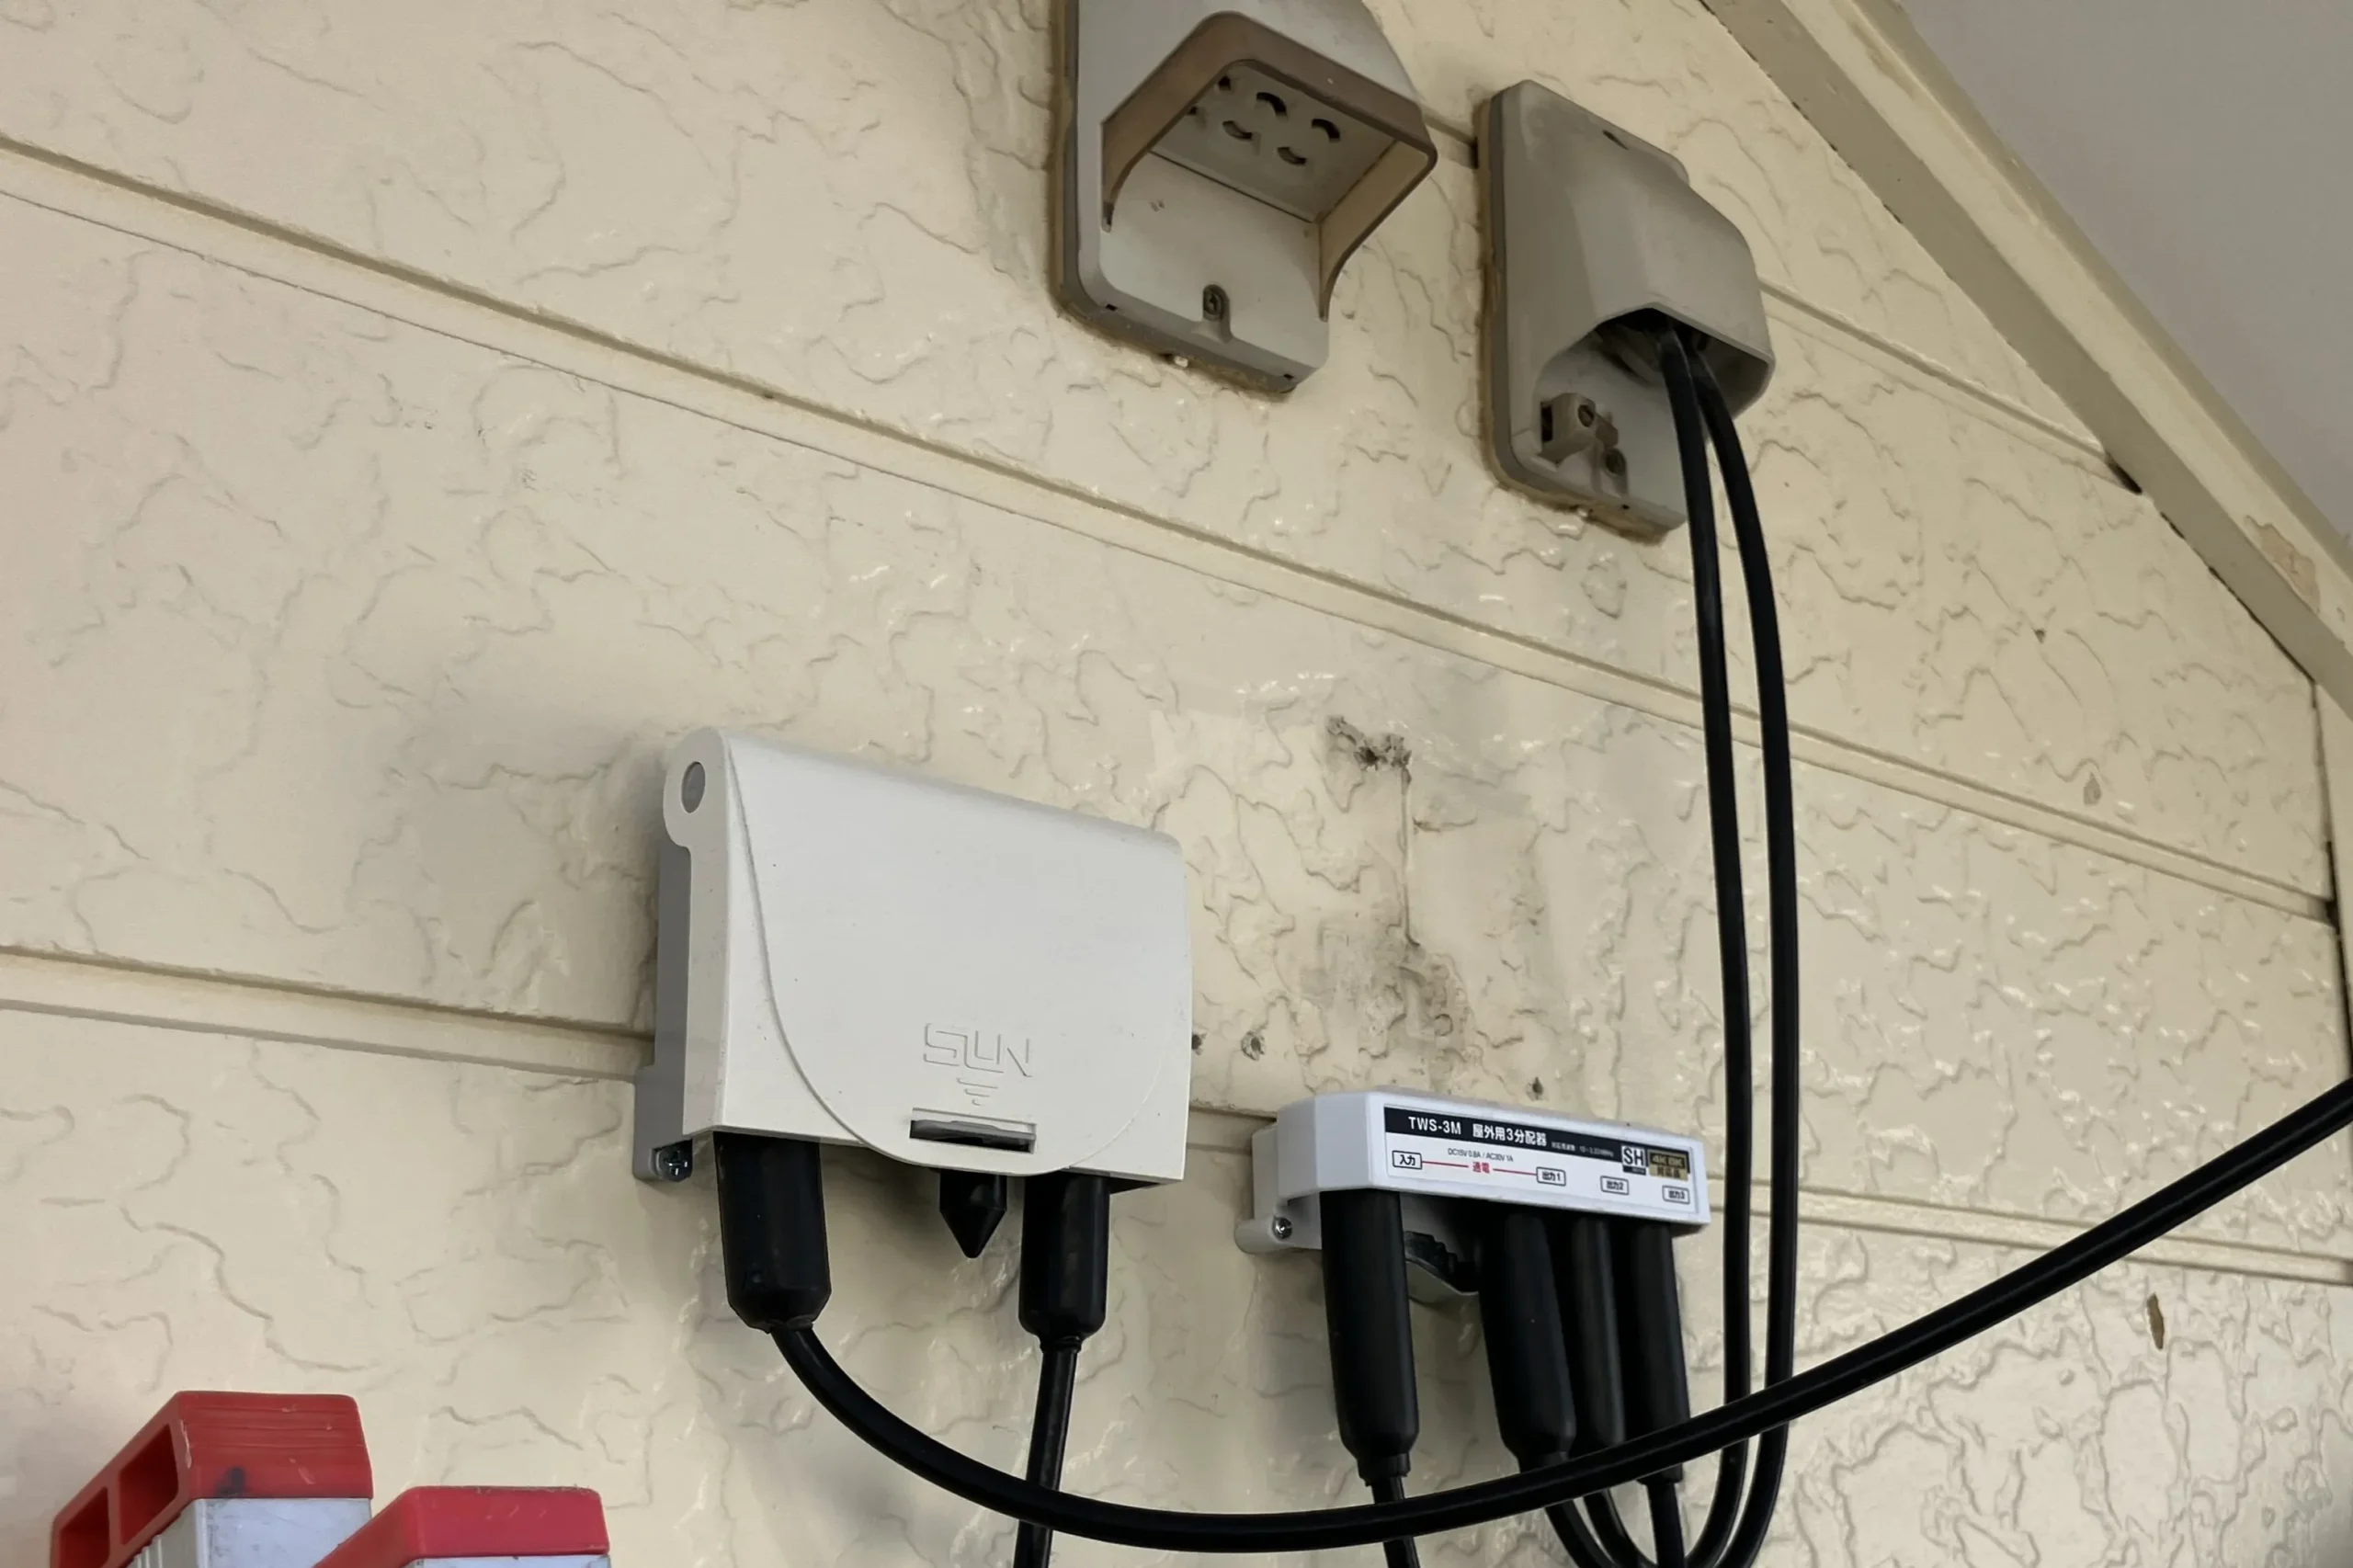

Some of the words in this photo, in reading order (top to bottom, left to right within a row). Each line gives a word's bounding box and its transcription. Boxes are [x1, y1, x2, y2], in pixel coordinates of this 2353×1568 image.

[924, 1022, 1033, 1078] SUN
[1408, 1116, 1461, 1135] TWS-3M
[1472, 1123, 1547, 1147] 屋外用3分配器
[1399, 1154, 1416, 1166] 入力
[1623, 1147, 1644, 1166] SH
